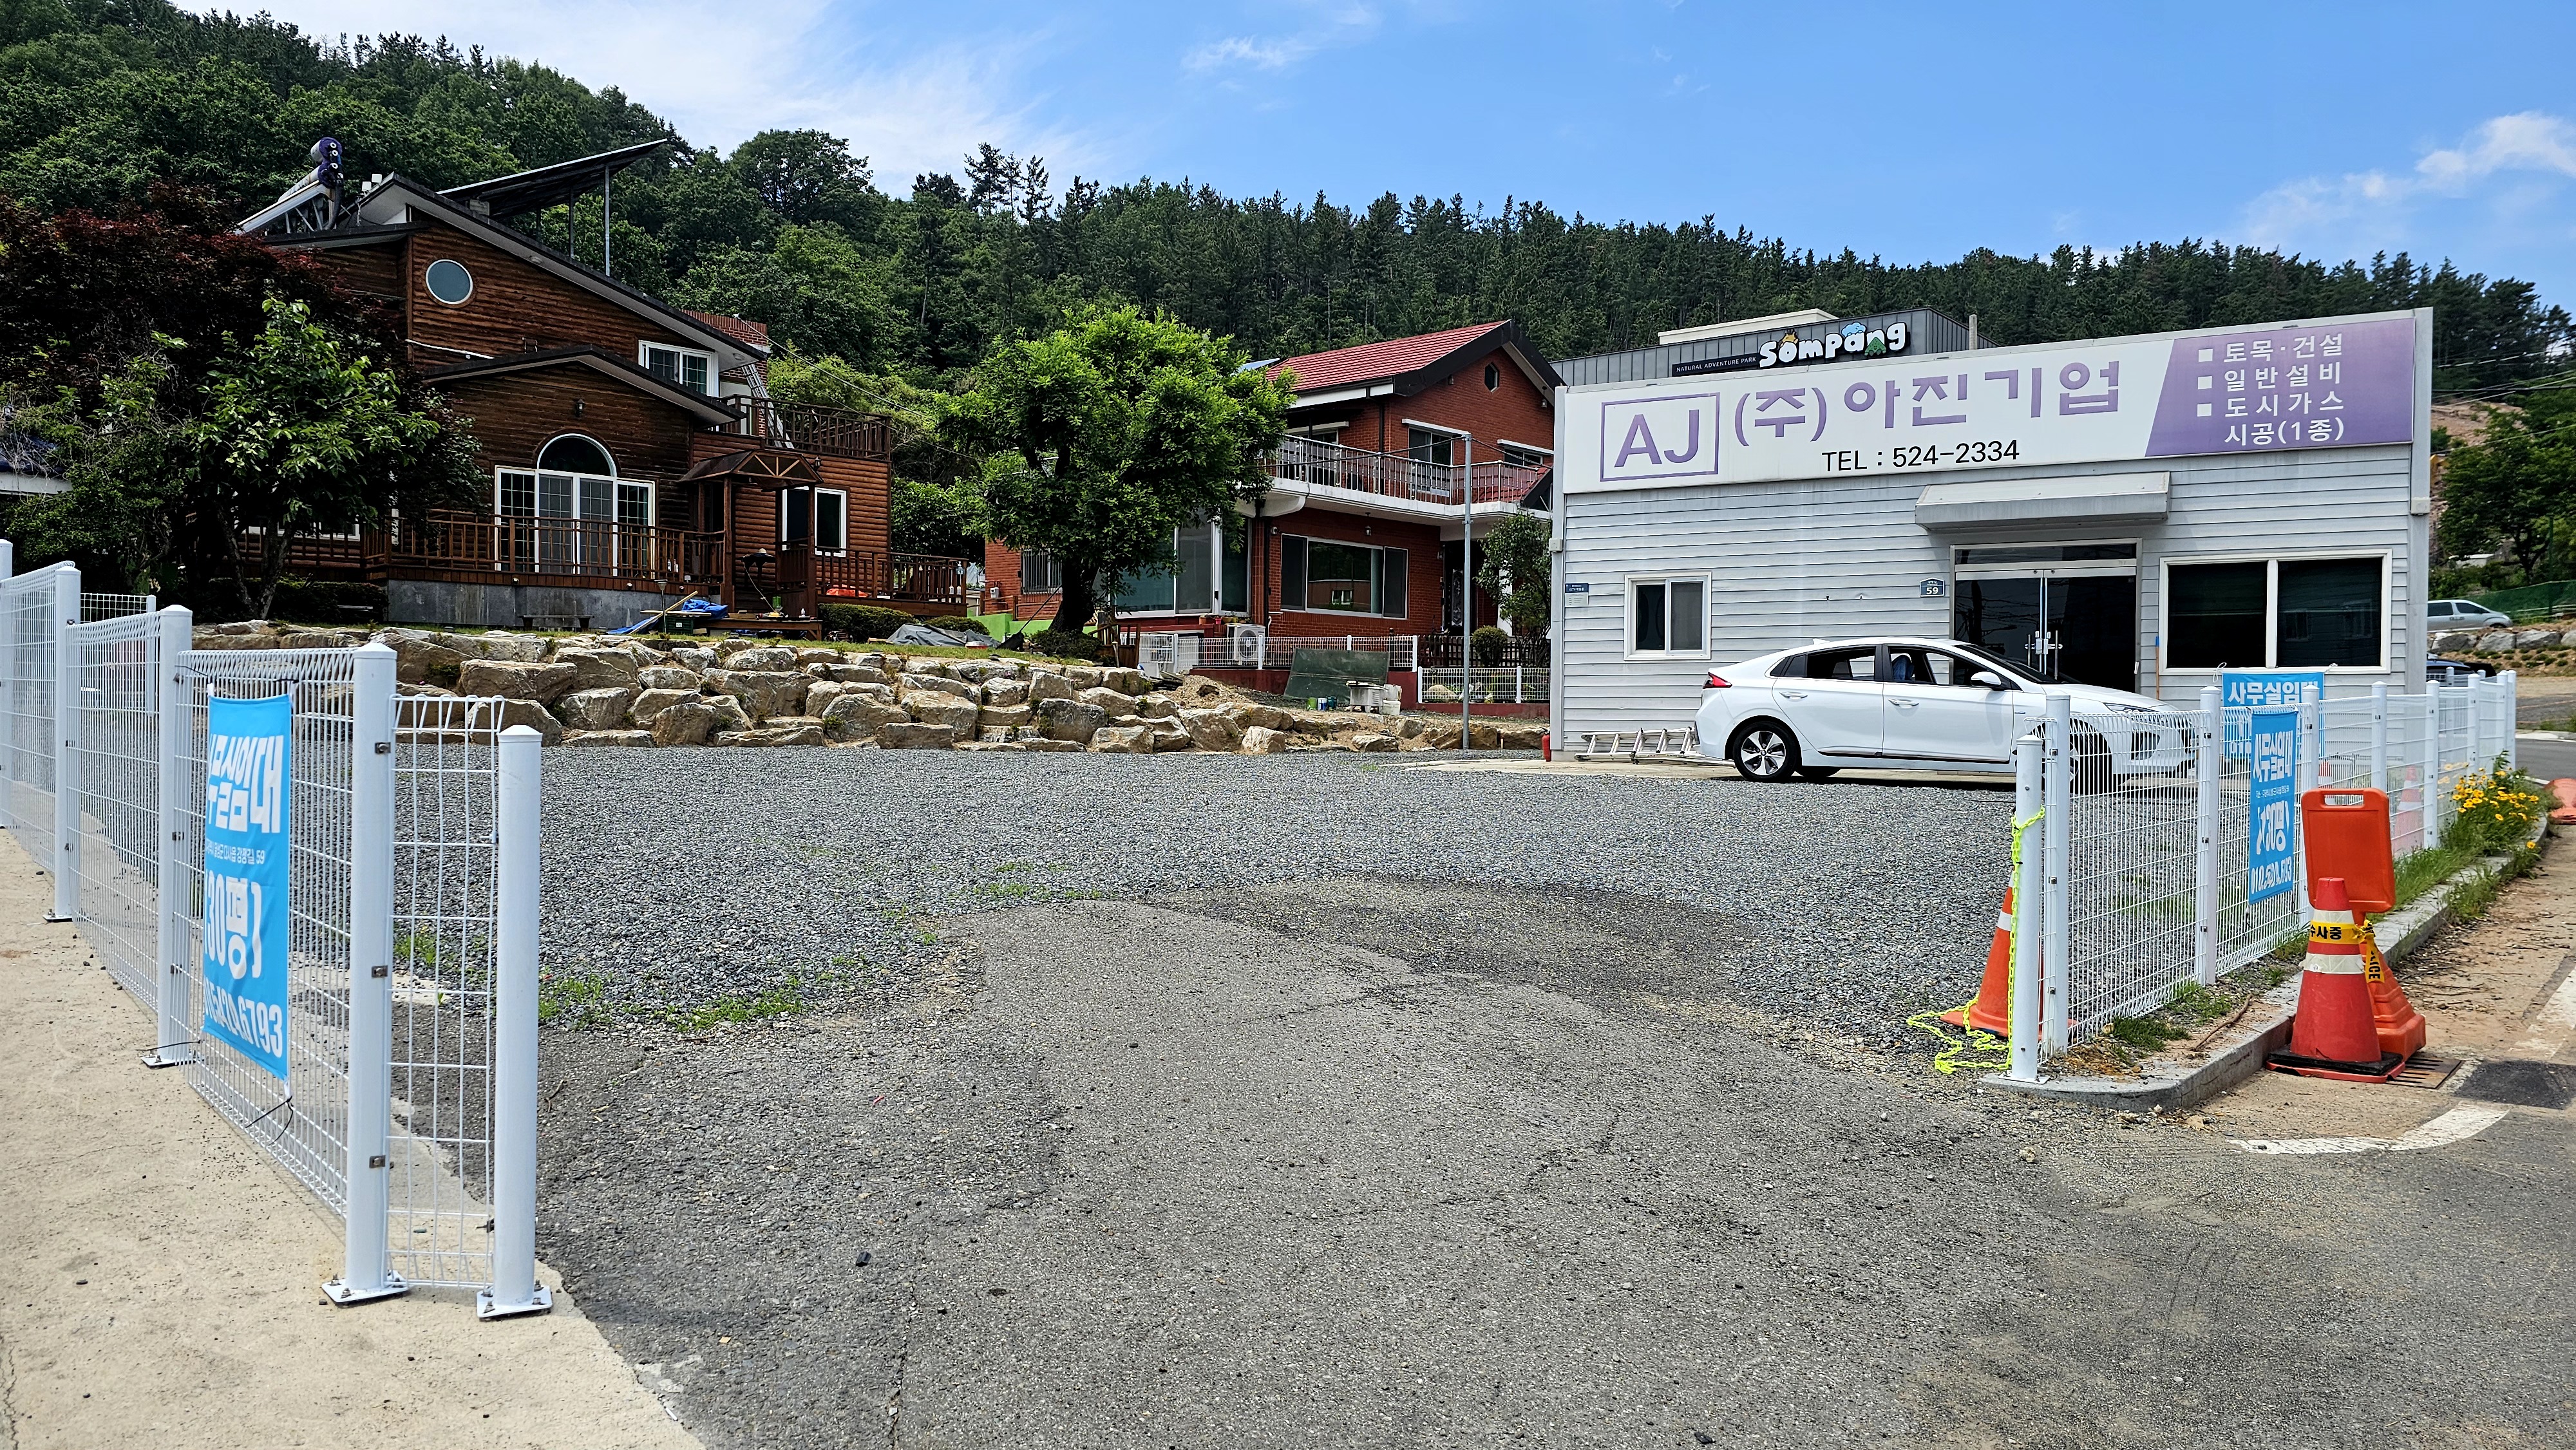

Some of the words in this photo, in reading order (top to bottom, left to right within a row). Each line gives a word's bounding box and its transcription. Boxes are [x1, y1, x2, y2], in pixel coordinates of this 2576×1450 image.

[1676, 364, 1703, 373] NATURAL
[1704, 358, 1739, 369] ADVENTURE
[1614, 410, 1700, 468] AJ
[2224, 417, 2345, 446] 시공(1종)
[1821, 451, 1868, 472] TEL
[1892, 439, 2020, 468] 524-2334
[2228, 681, 2318, 705] 사무실임
[2253, 730, 2293, 782] 사무실임대
[256, 850, 265, 865] 59
[205, 868, 261, 979] 30평)
[2310, 925, 2342, 940] 수사중
